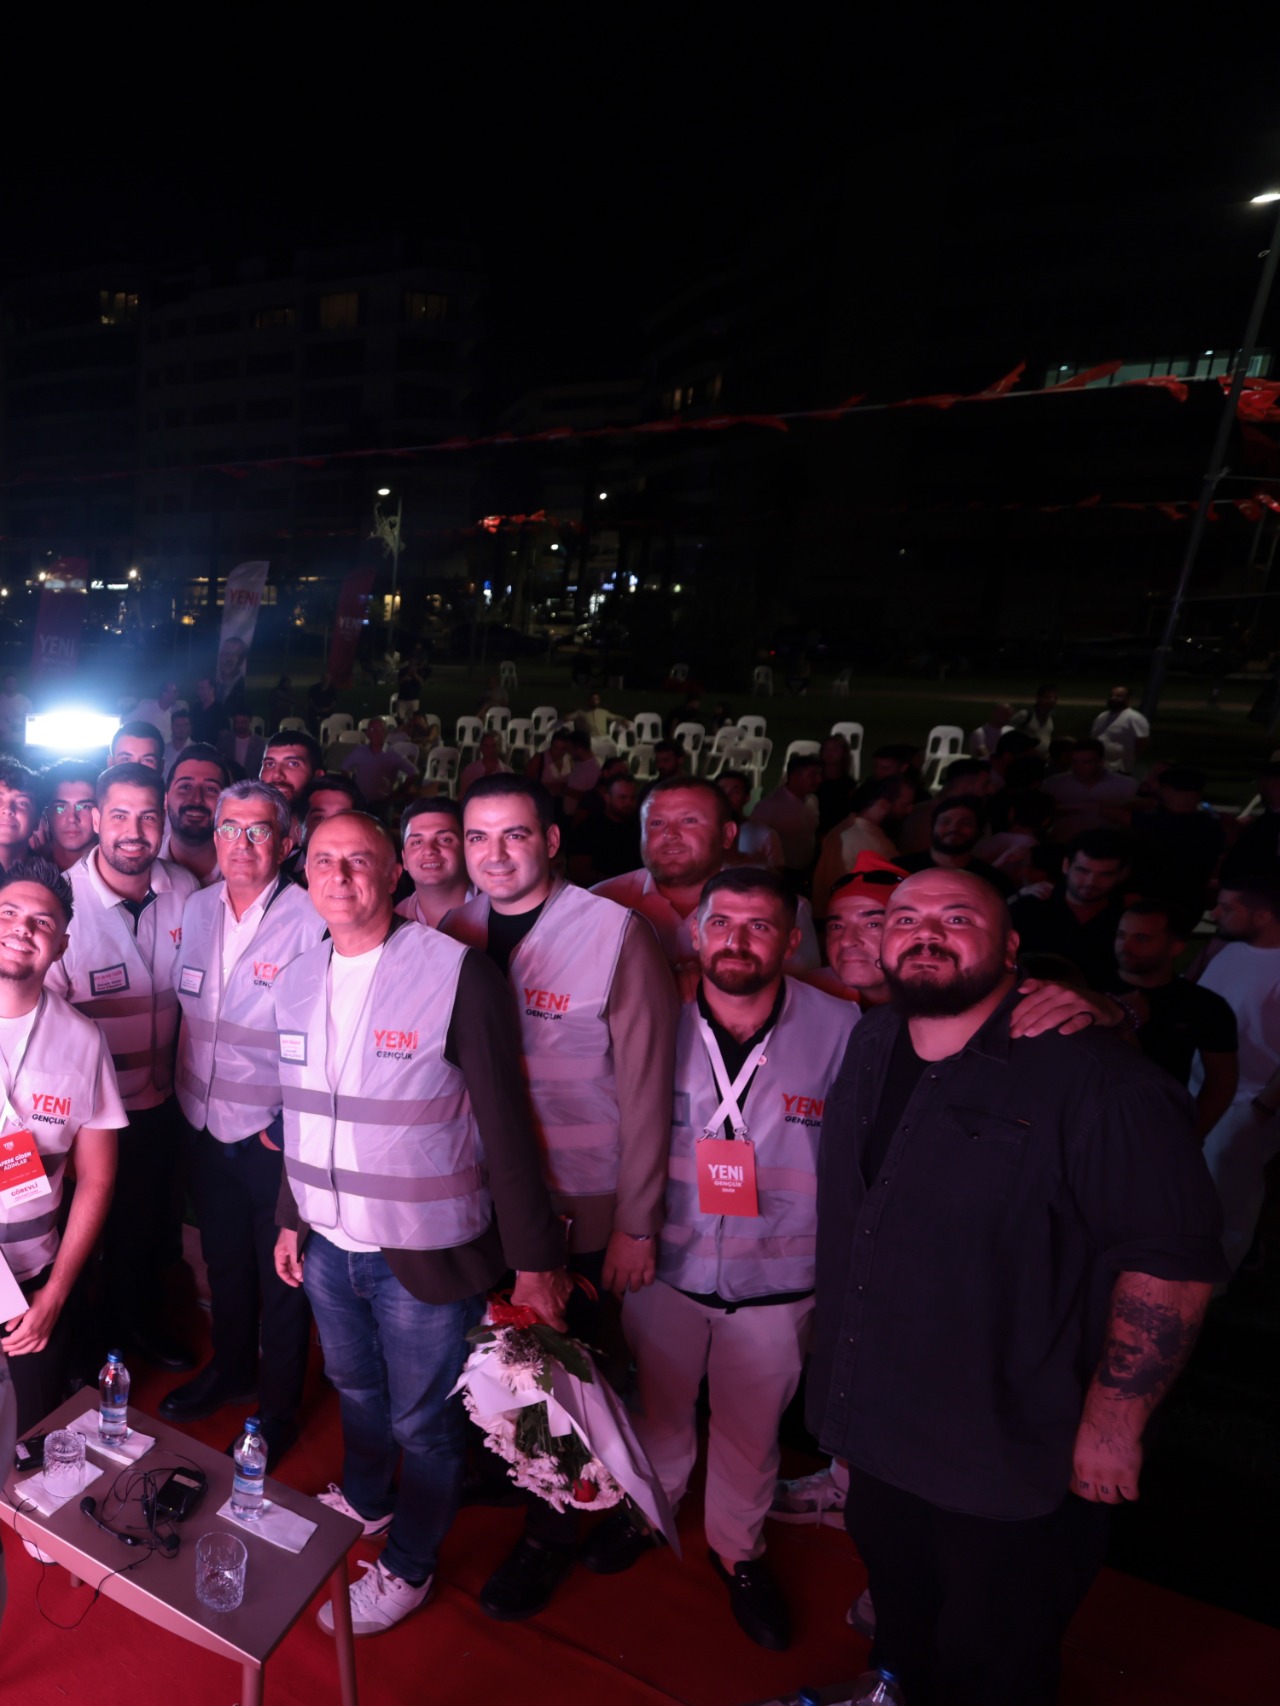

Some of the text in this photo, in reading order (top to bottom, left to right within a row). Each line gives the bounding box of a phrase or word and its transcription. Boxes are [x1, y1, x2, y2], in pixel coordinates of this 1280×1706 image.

[32, 1093, 72, 1117] YENİ
[782, 1092, 824, 1118] YEN
[708, 1164, 744, 1181] YENİ
